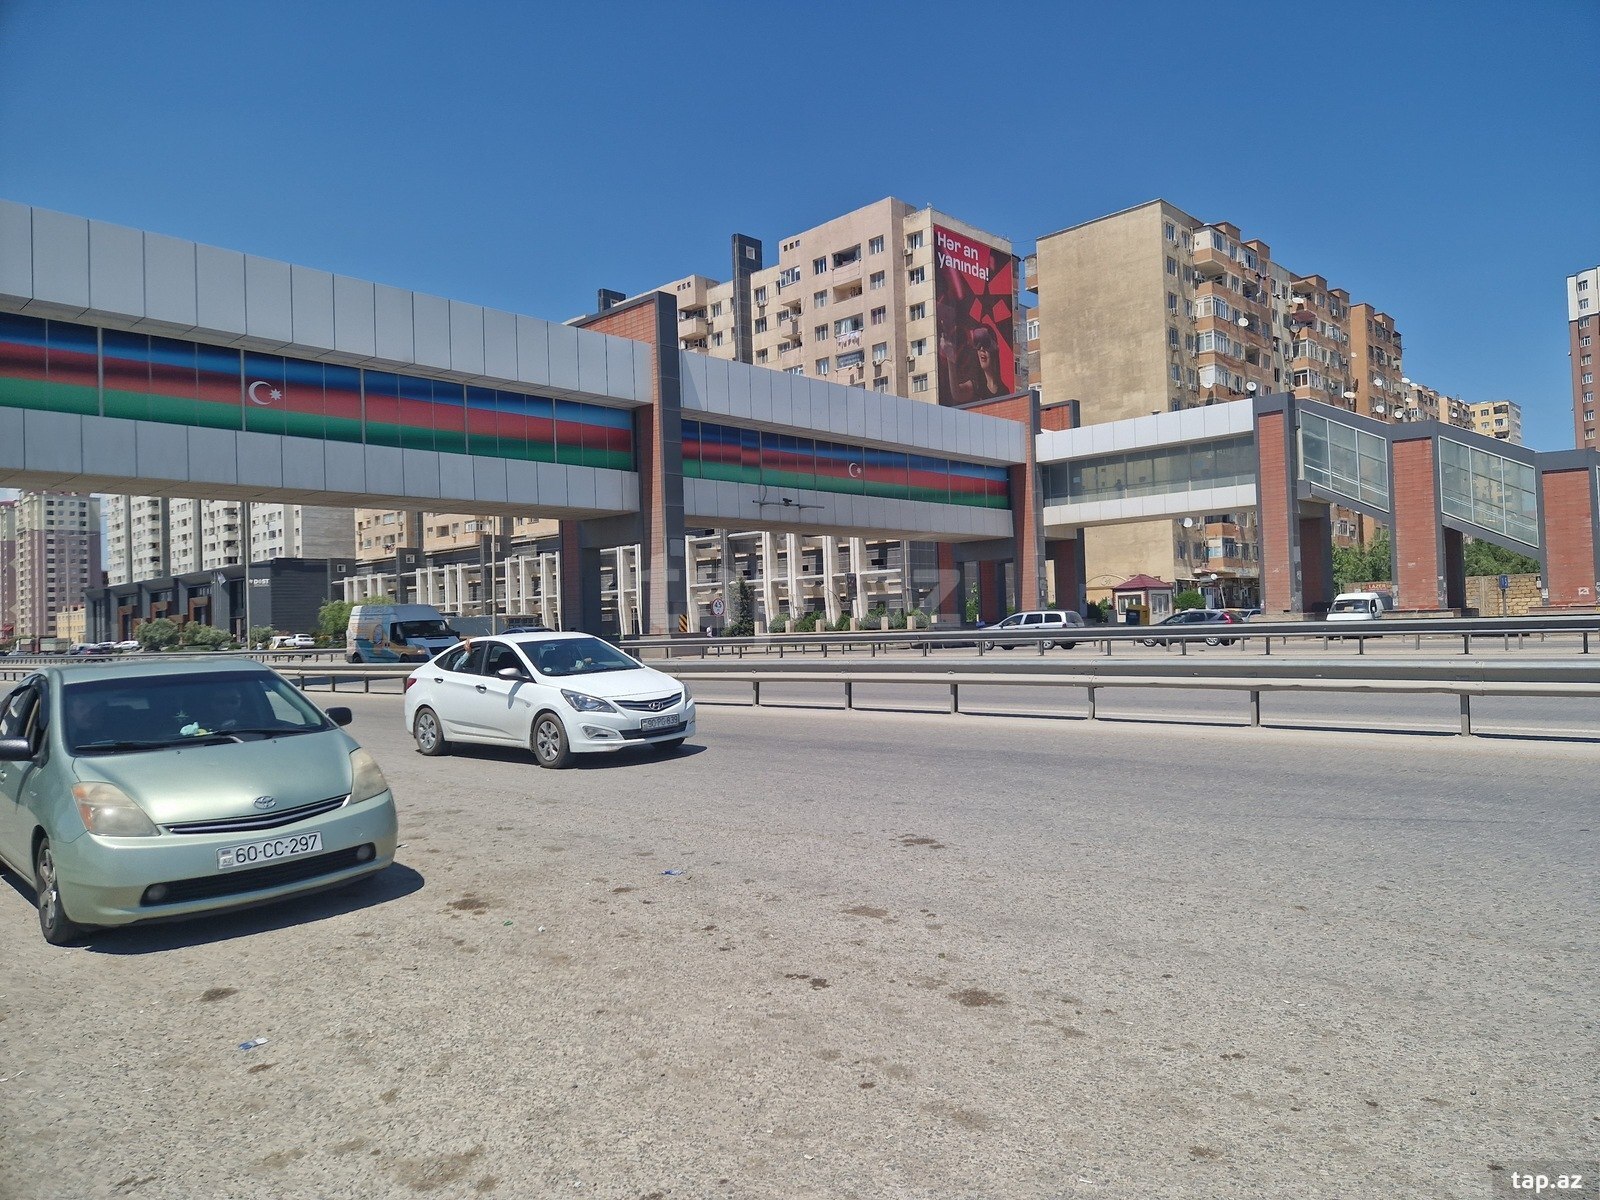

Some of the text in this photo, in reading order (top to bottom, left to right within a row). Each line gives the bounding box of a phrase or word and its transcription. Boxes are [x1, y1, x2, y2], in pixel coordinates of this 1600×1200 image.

[937, 231, 979, 261] Hər an
[937, 251, 989, 281] yanında!
[235, 834, 319, 864] 60-CC-297
